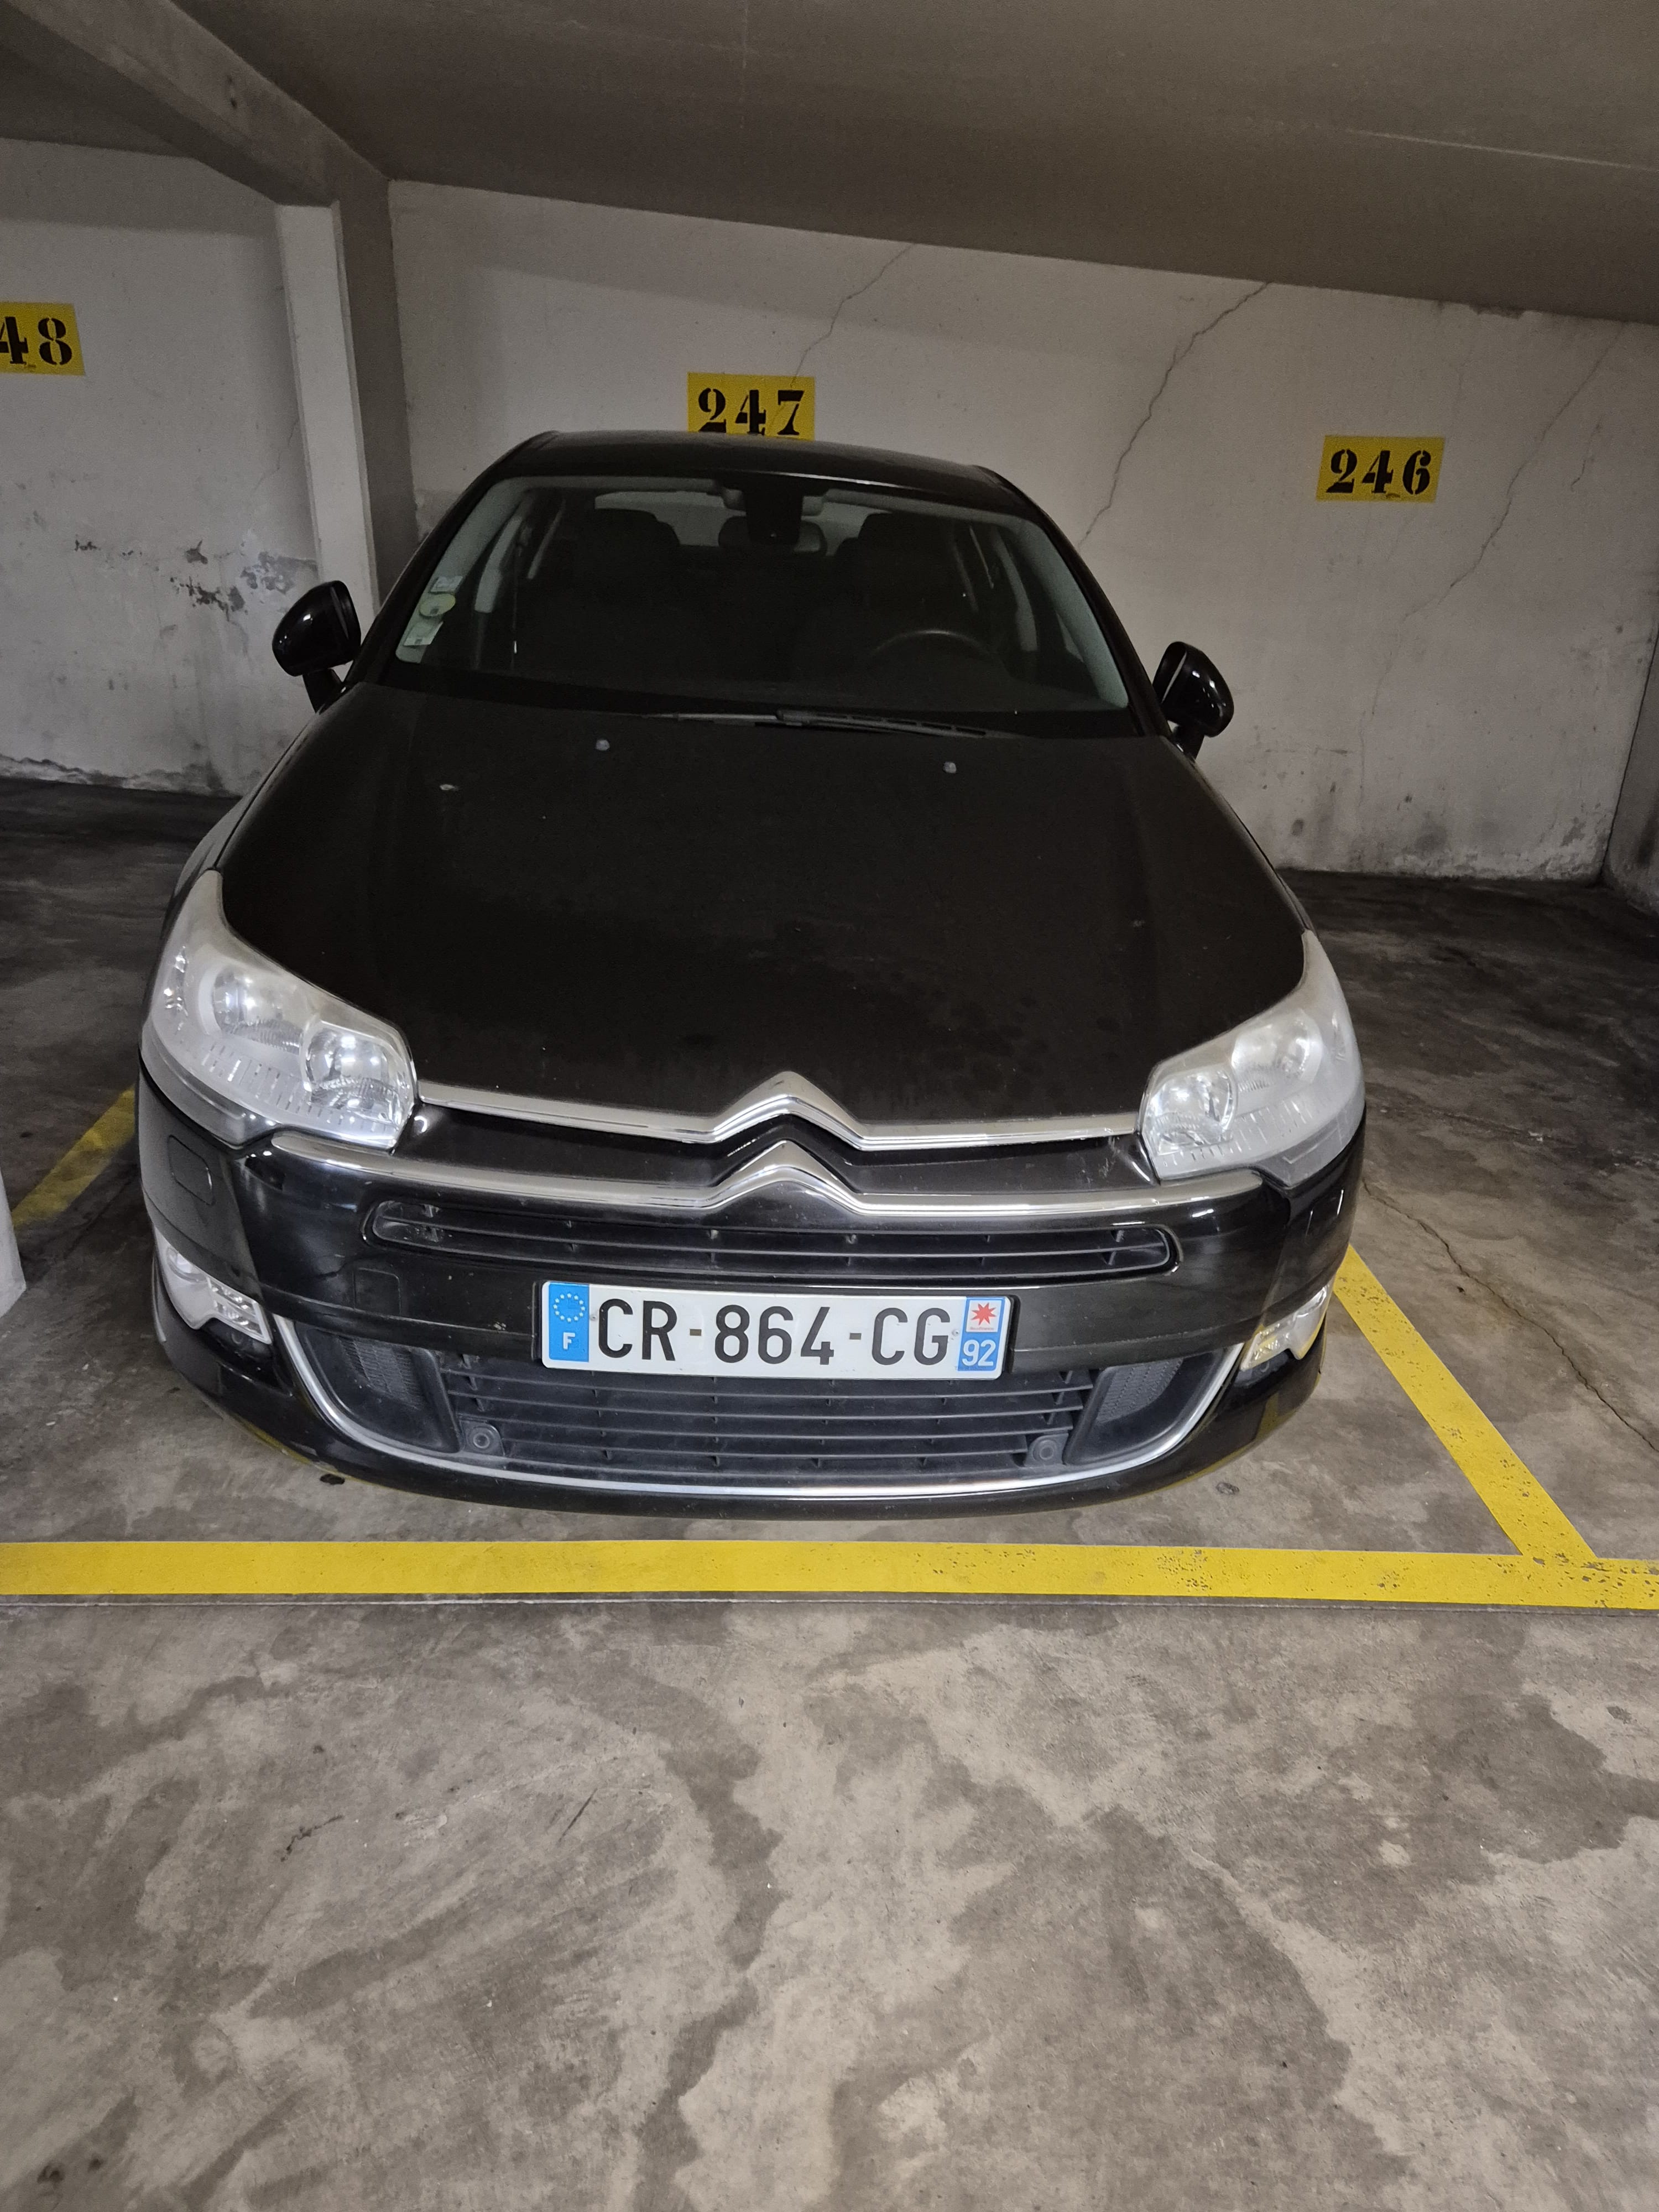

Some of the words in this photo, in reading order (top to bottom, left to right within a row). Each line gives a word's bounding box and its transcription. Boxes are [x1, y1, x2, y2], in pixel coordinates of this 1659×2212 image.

[0, 316, 72, 365] 48
[698, 388, 805, 436] 247
[1326, 449, 1431, 495] 246
[562, 1332, 576, 1350] F
[598, 1298, 951, 1365] CR-864-CG
[962, 1339, 996, 1366] 92
